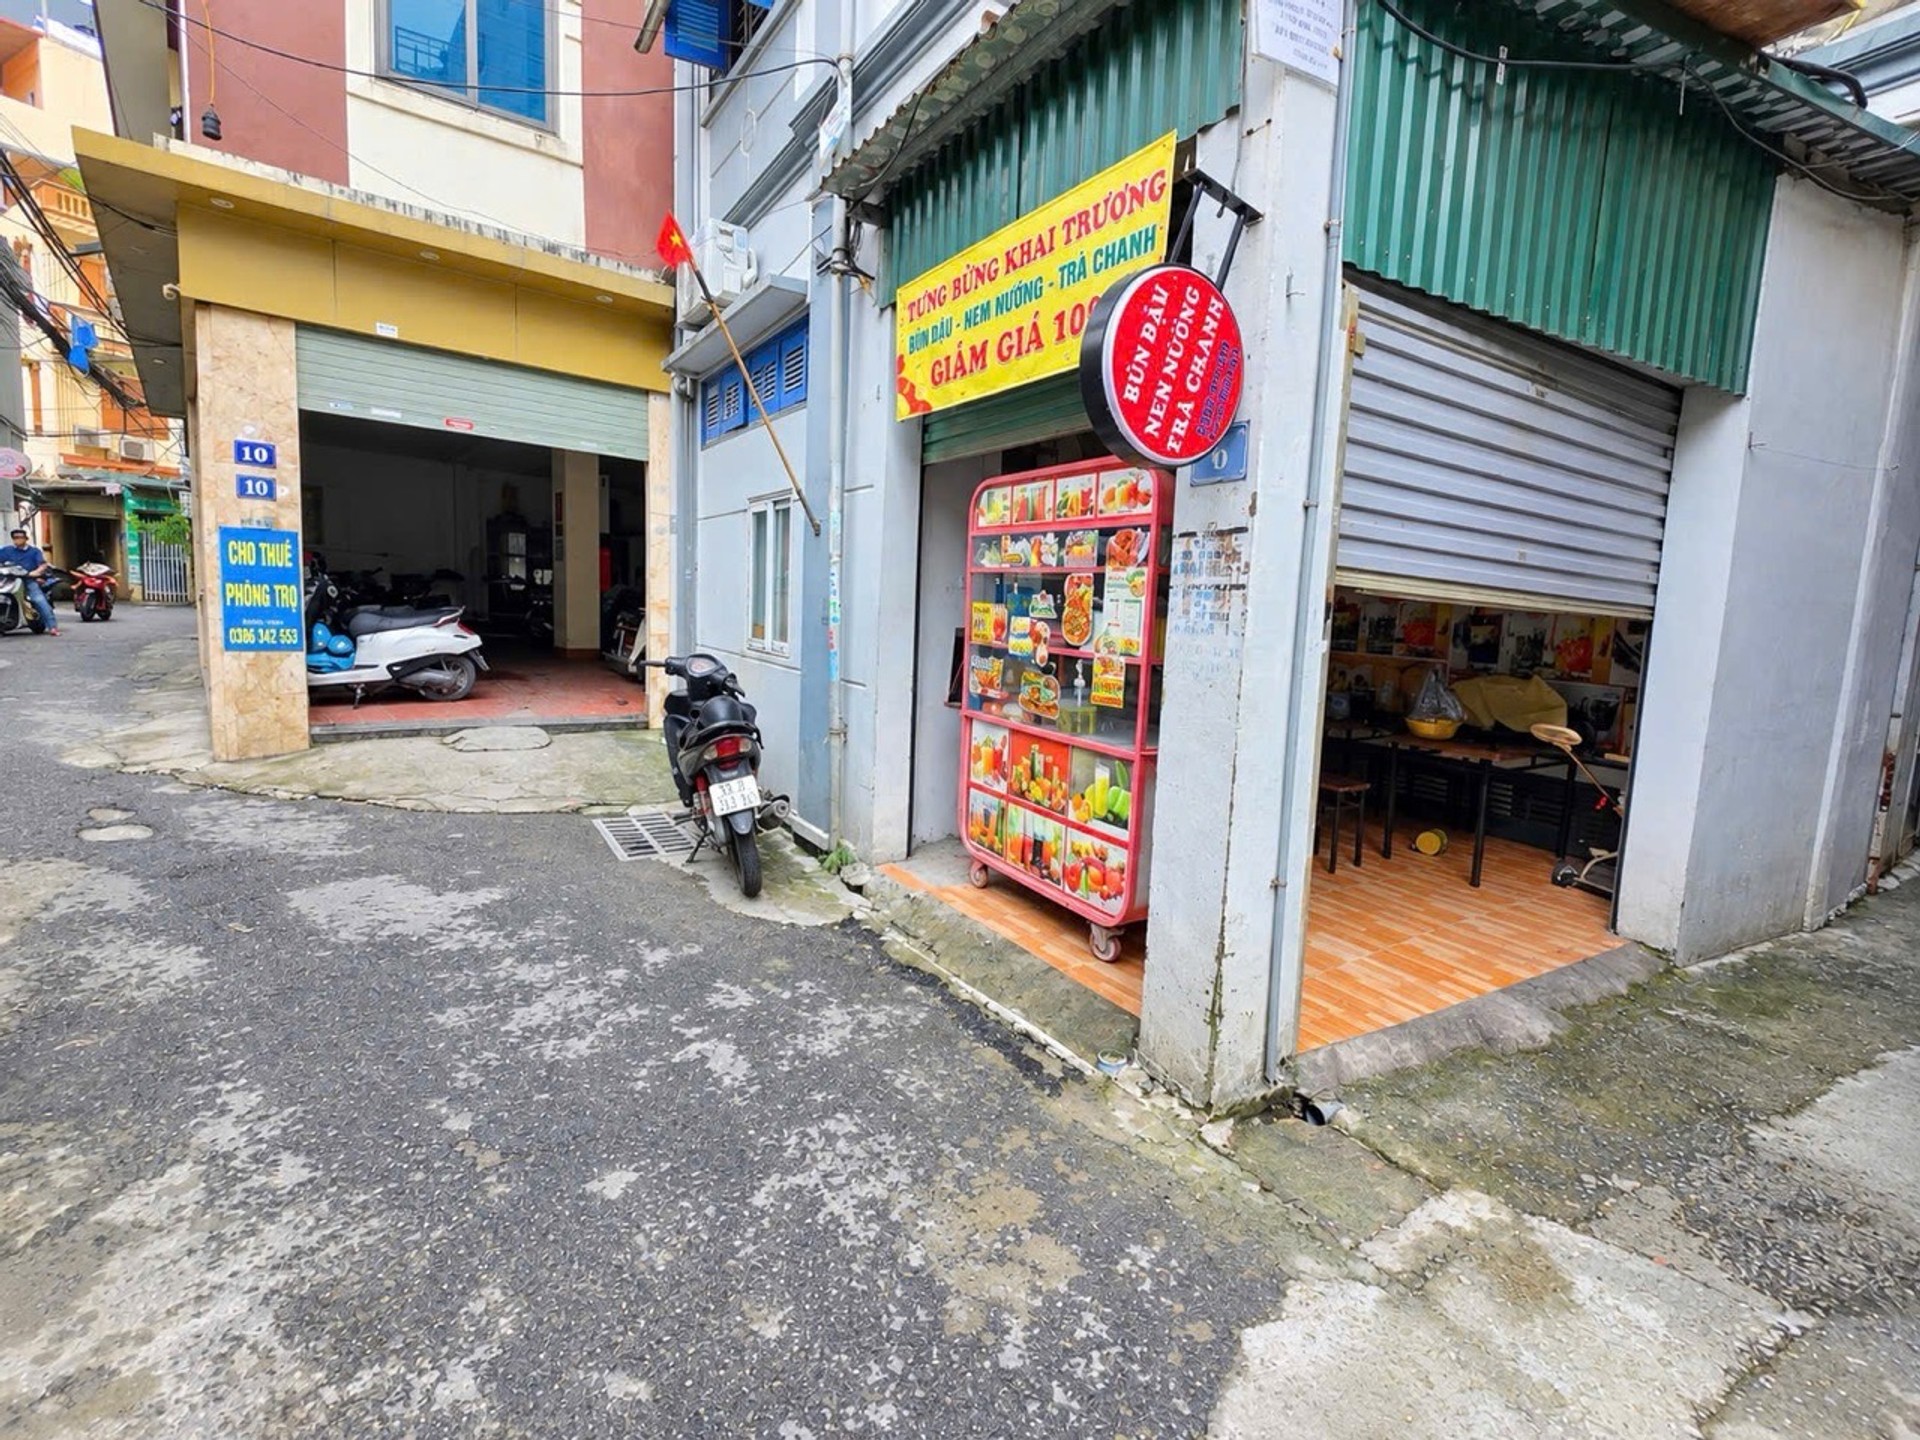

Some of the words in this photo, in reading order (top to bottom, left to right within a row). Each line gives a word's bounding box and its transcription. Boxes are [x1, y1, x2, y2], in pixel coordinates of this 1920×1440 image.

[1003, 225, 1056, 275] KHAI
[1062, 169, 1166, 246] TRƯƠNG
[963, 299, 991, 330] NEM
[1093, 223, 1157, 274] CHANH
[930, 339, 989, 388] GIẢM
[996, 310, 1045, 364] GIÁ
[1053, 294, 1101, 342] 10
[1186, 295, 1225, 393] CHANH
[241, 445, 268, 463] 10
[244, 479, 268, 496] 10
[227, 539, 256, 566] CHO
[224, 579, 271, 608] PHÒNG
[273, 583, 298, 613] TRỌ
[257, 628, 278, 644] 342
